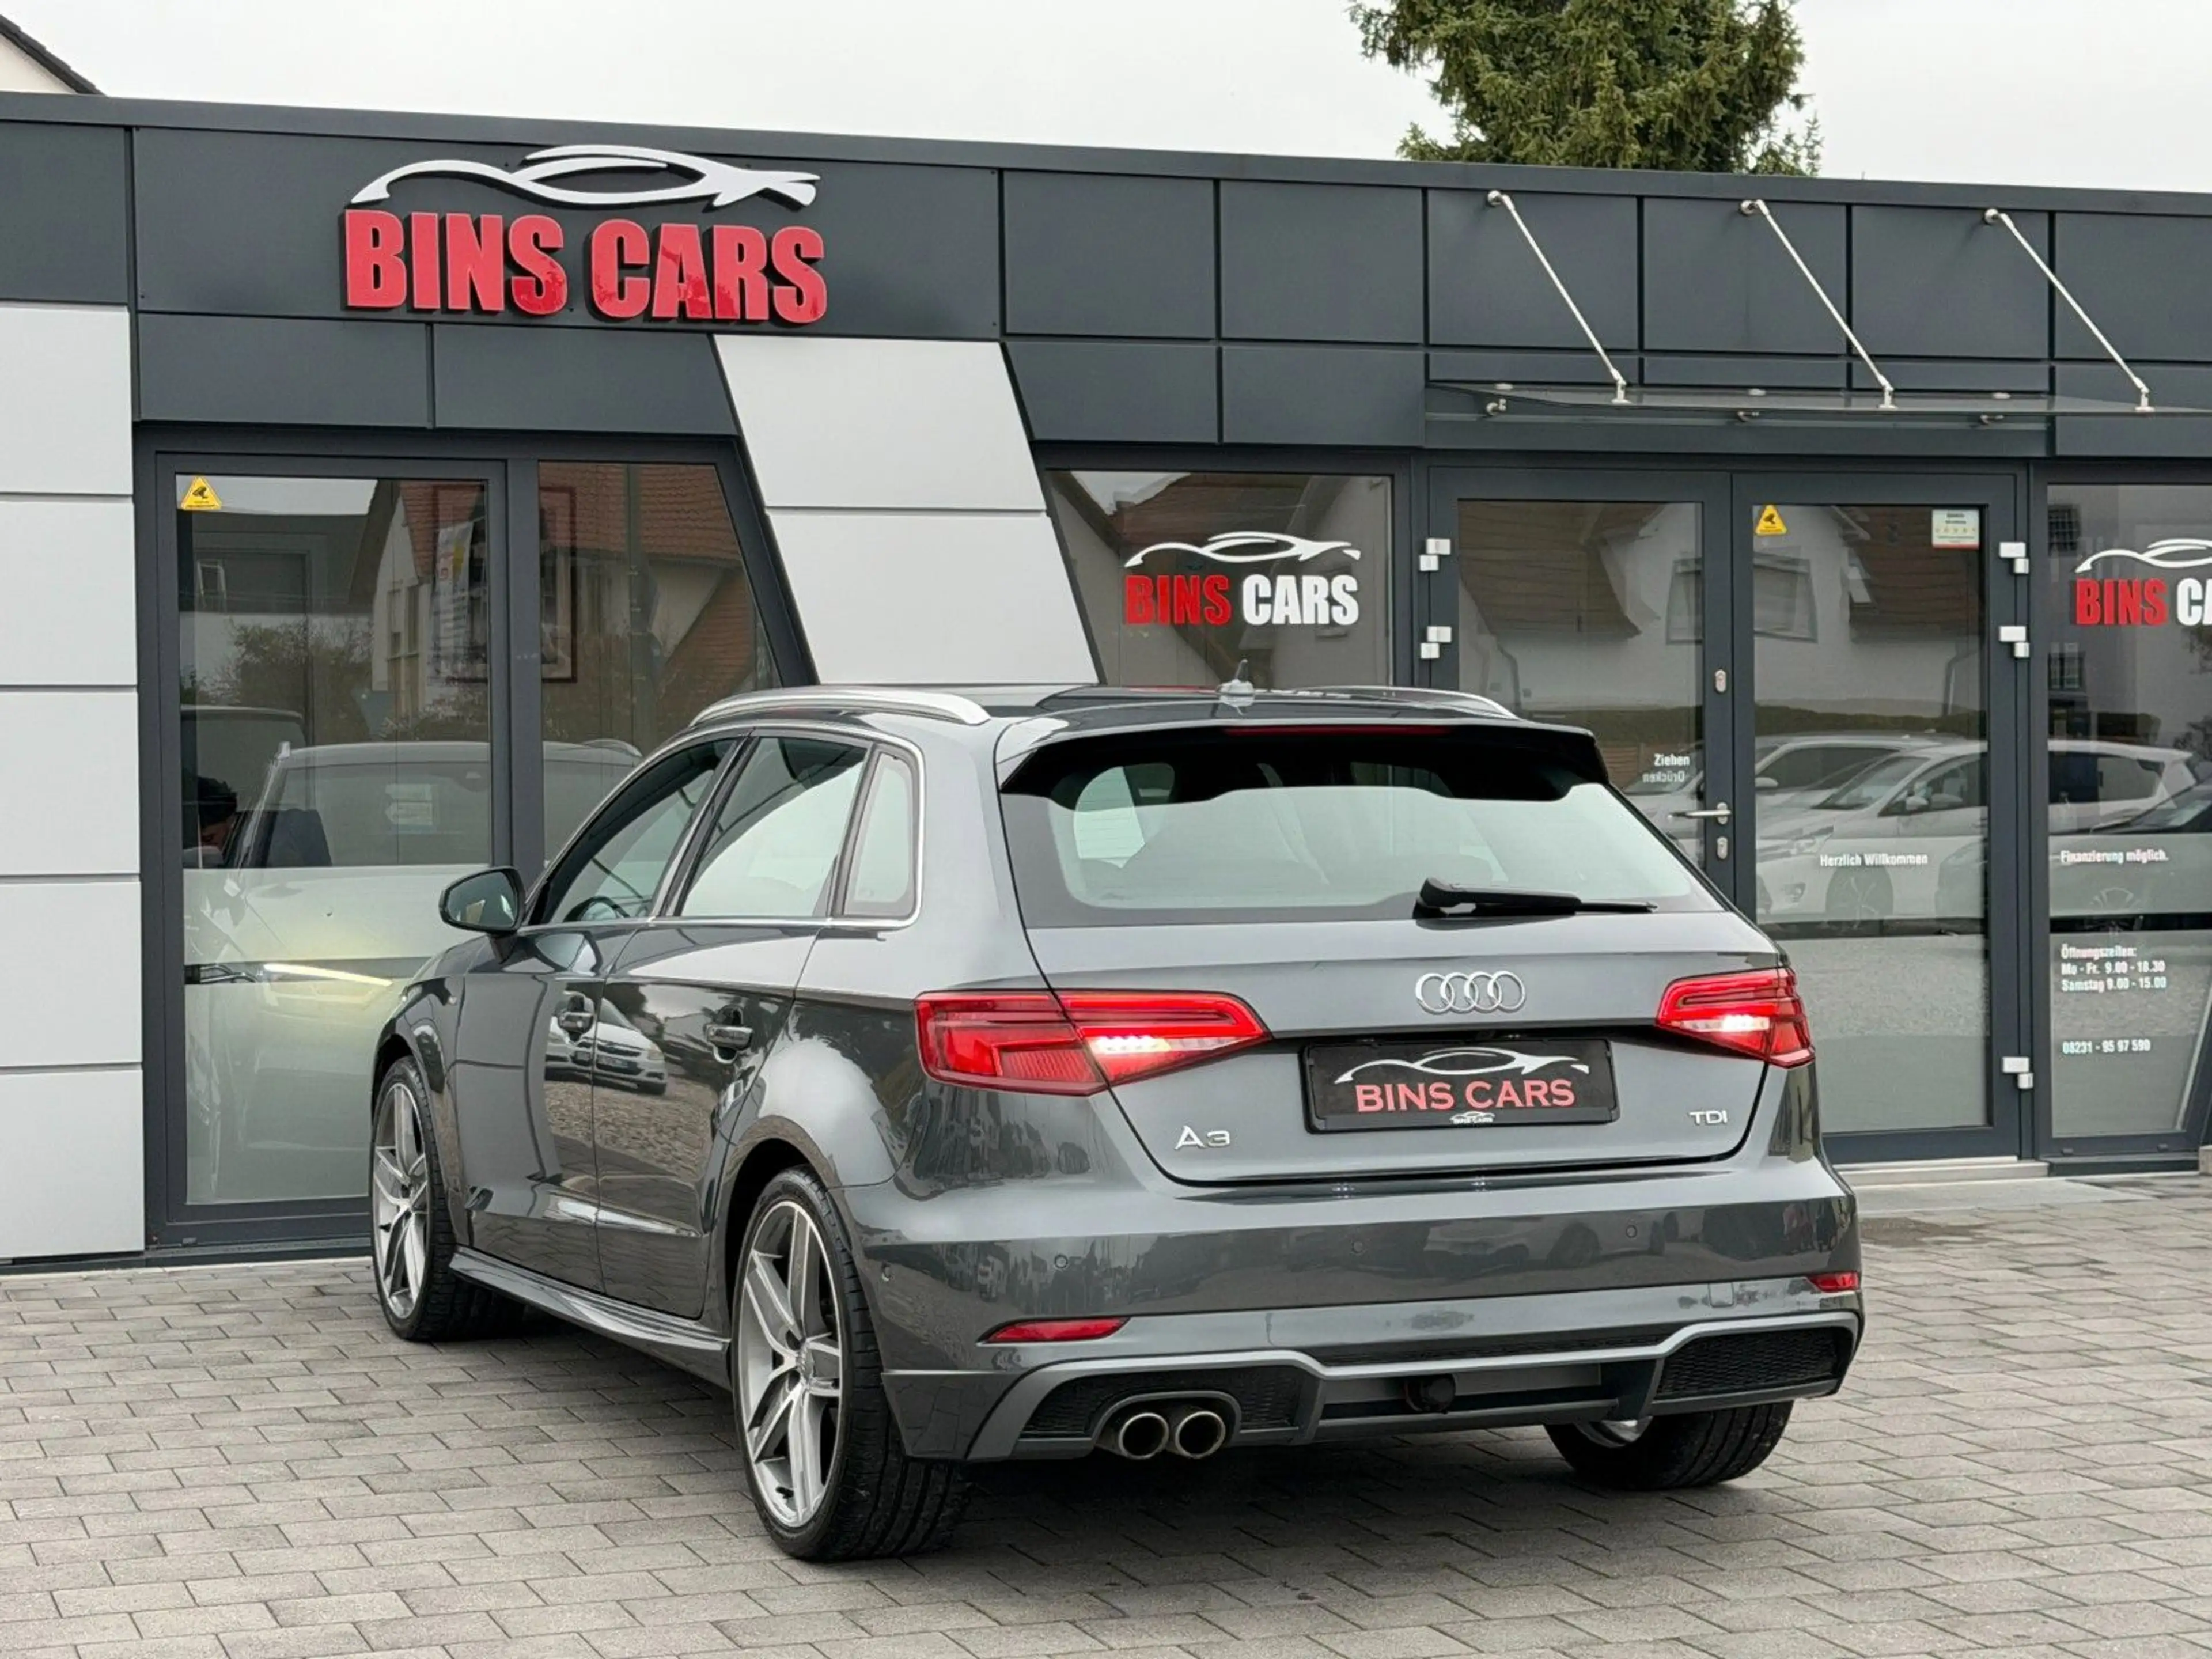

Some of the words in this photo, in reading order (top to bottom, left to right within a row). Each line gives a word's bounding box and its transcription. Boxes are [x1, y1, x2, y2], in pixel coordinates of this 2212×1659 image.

[345, 209, 568, 315] BINS
[591, 218, 827, 323] CARS
[1124, 574, 1232, 625] BINS
[1242, 574, 1359, 626] CARS
[2076, 578, 2168, 626] BINS
[1653, 753, 1691, 767] Ziehen
[1820, 853, 1862, 866] Herzlich
[1863, 853, 1928, 865] Willkommen
[2061, 850, 2124, 865] Finanzierung
[2061, 979, 2105, 993] Samstag
[2138, 976, 2168, 989] 15.00
[1355, 1081, 1455, 1112] BINS
[1465, 1078, 1575, 1108] CARS
[1688, 1109, 1728, 1124] TDI
[1175, 1124, 1230, 1150] A3
